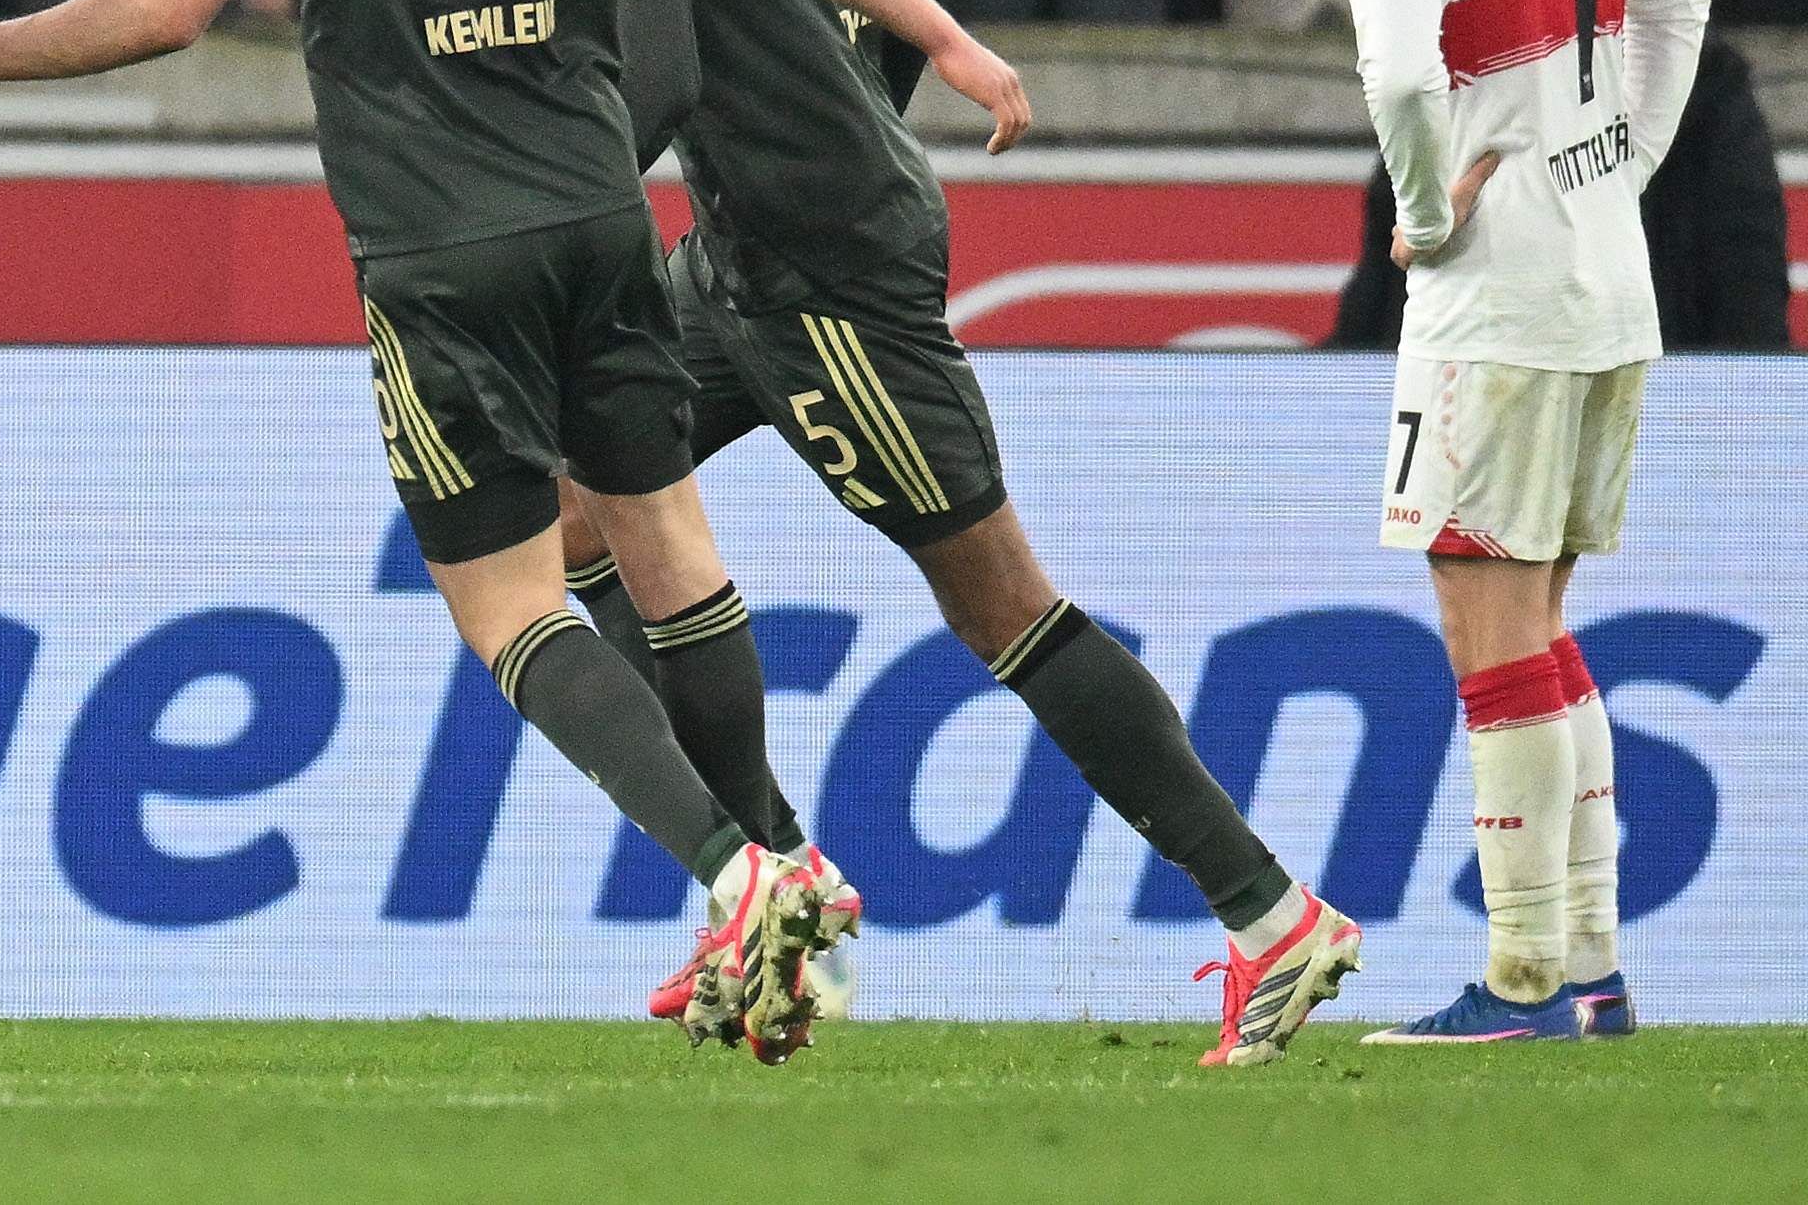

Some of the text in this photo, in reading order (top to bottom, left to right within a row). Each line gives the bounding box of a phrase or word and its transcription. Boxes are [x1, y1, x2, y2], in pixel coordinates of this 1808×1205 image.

[788, 389, 858, 475] 5
[1394, 410, 1423, 495] 7
[1386, 507, 1423, 526] JAKO
